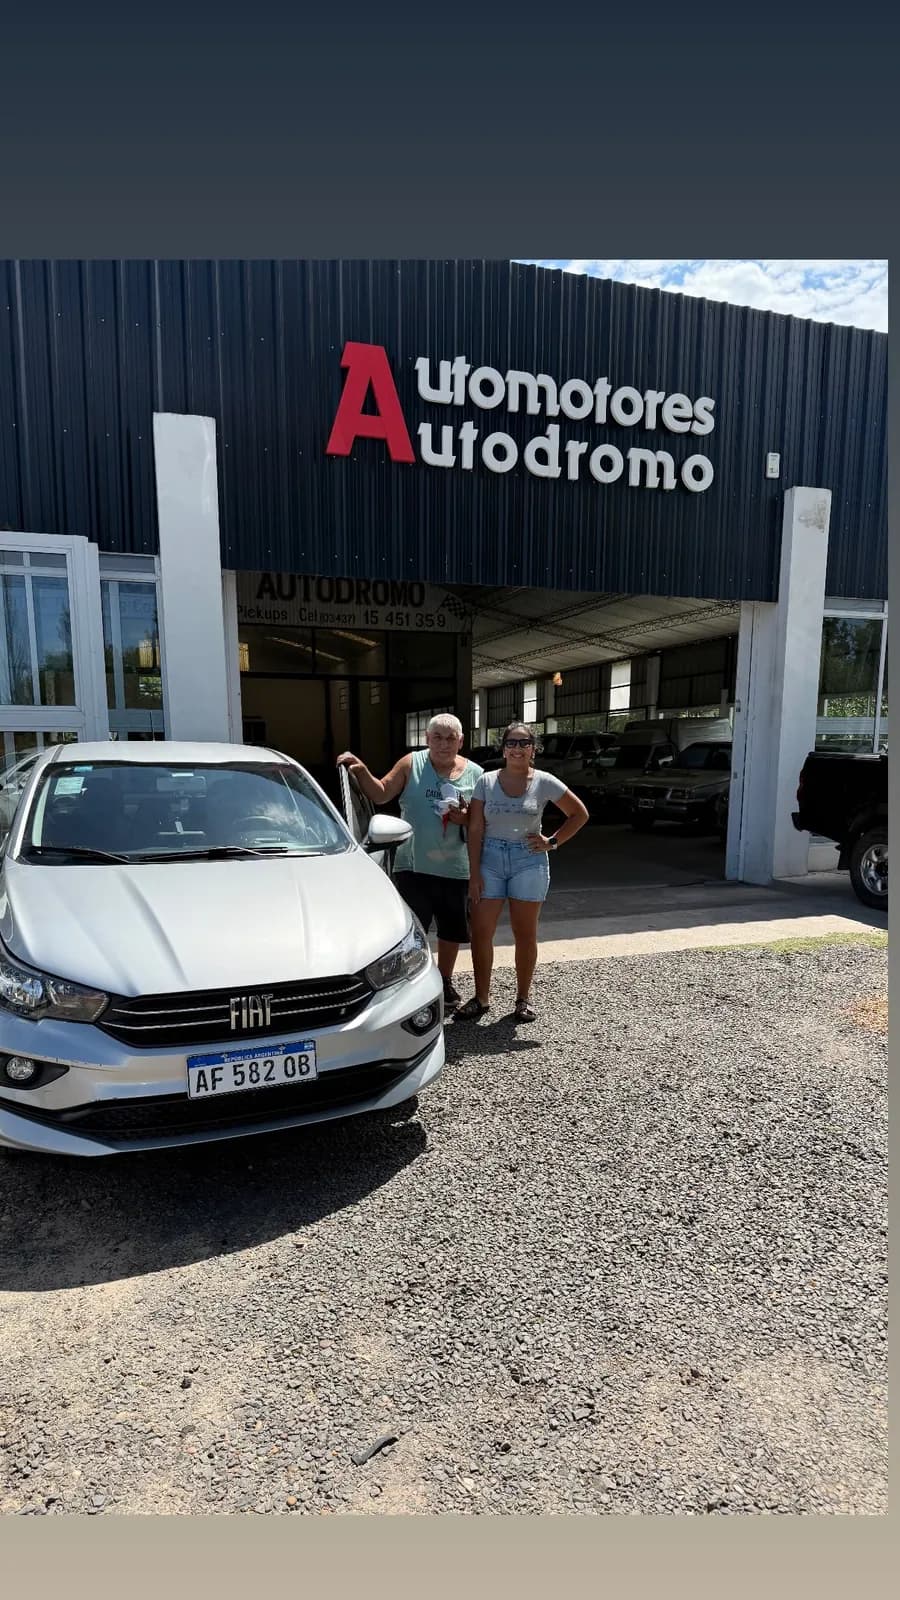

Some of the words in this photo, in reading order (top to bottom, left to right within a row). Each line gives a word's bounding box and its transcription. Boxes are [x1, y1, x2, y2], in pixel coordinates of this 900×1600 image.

[256, 572, 425, 608] AUTODROMO
[363, 609, 379, 625] 15
[385, 612, 410, 627] 451
[415, 613, 446, 628] 359
[229, 993, 274, 1030] FIAT
[196, 1066, 224, 1093] AF
[232, 1059, 276, 1087] 582
